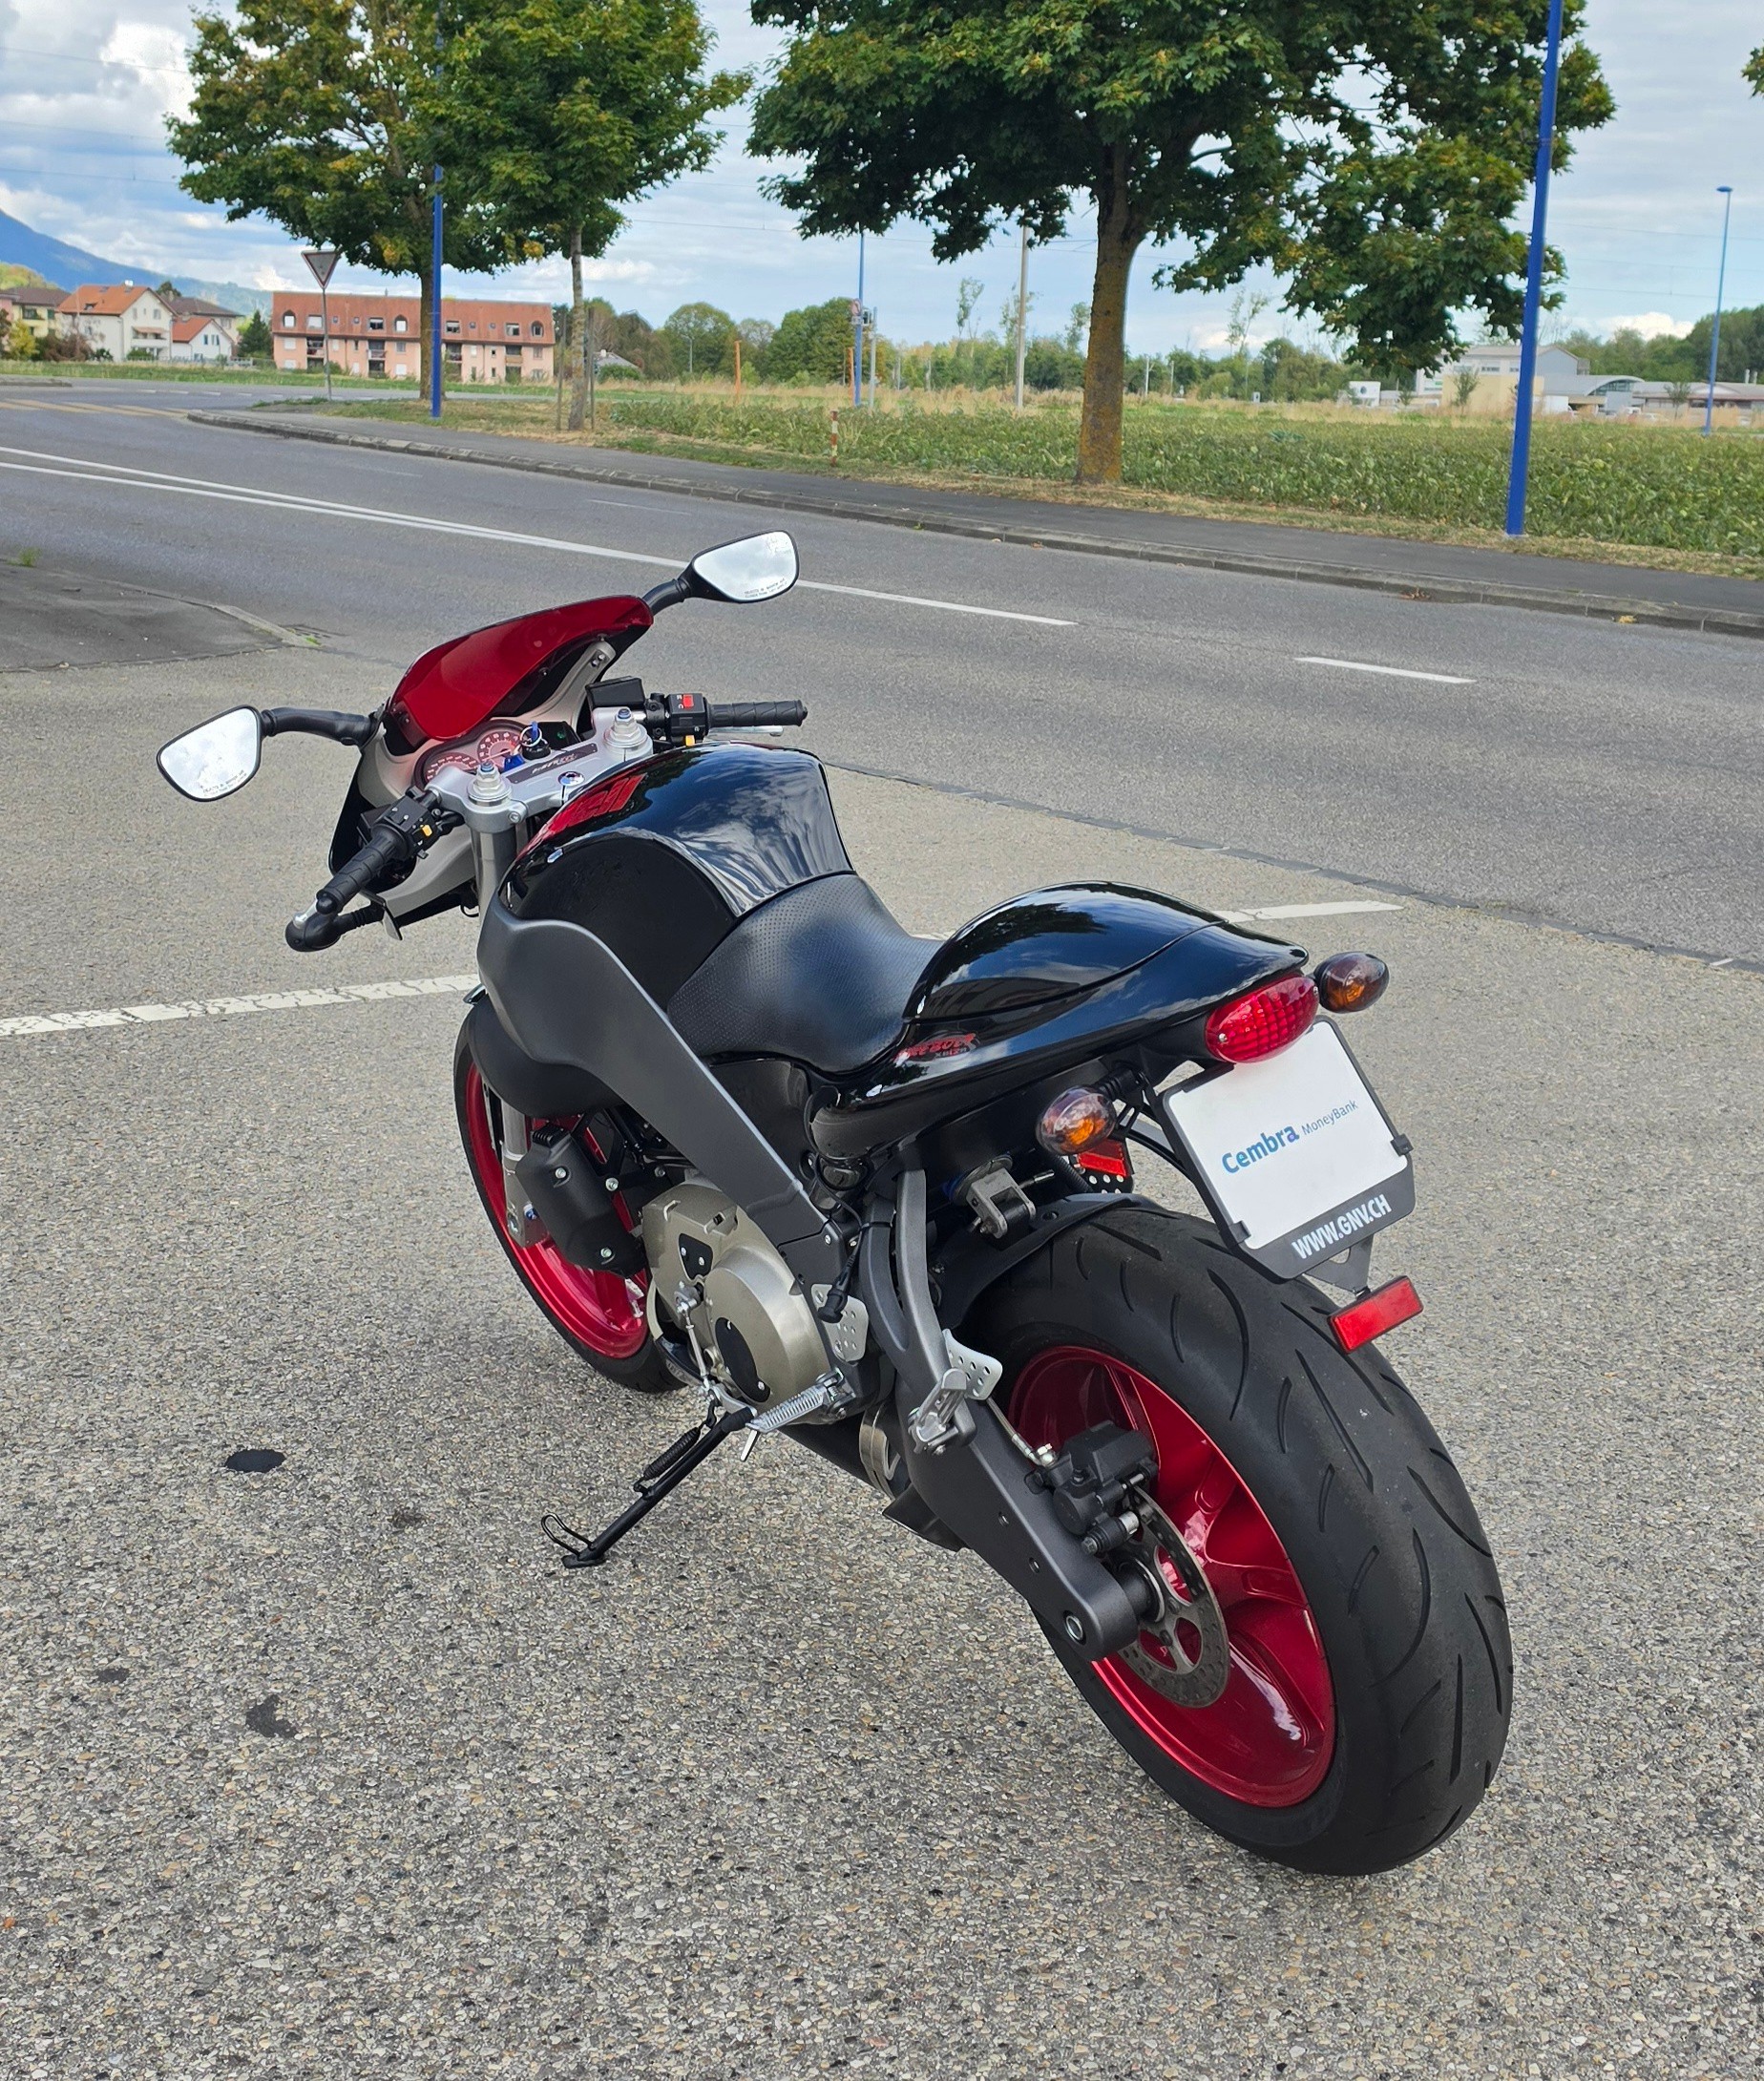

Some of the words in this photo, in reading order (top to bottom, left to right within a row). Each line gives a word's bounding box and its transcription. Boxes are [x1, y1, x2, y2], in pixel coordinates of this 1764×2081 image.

[1221, 1125, 1300, 1174] Cembra
[1301, 1099, 1359, 1136] MoneyBank
[1291, 1193, 1393, 1260] WWW.GNV.CH
